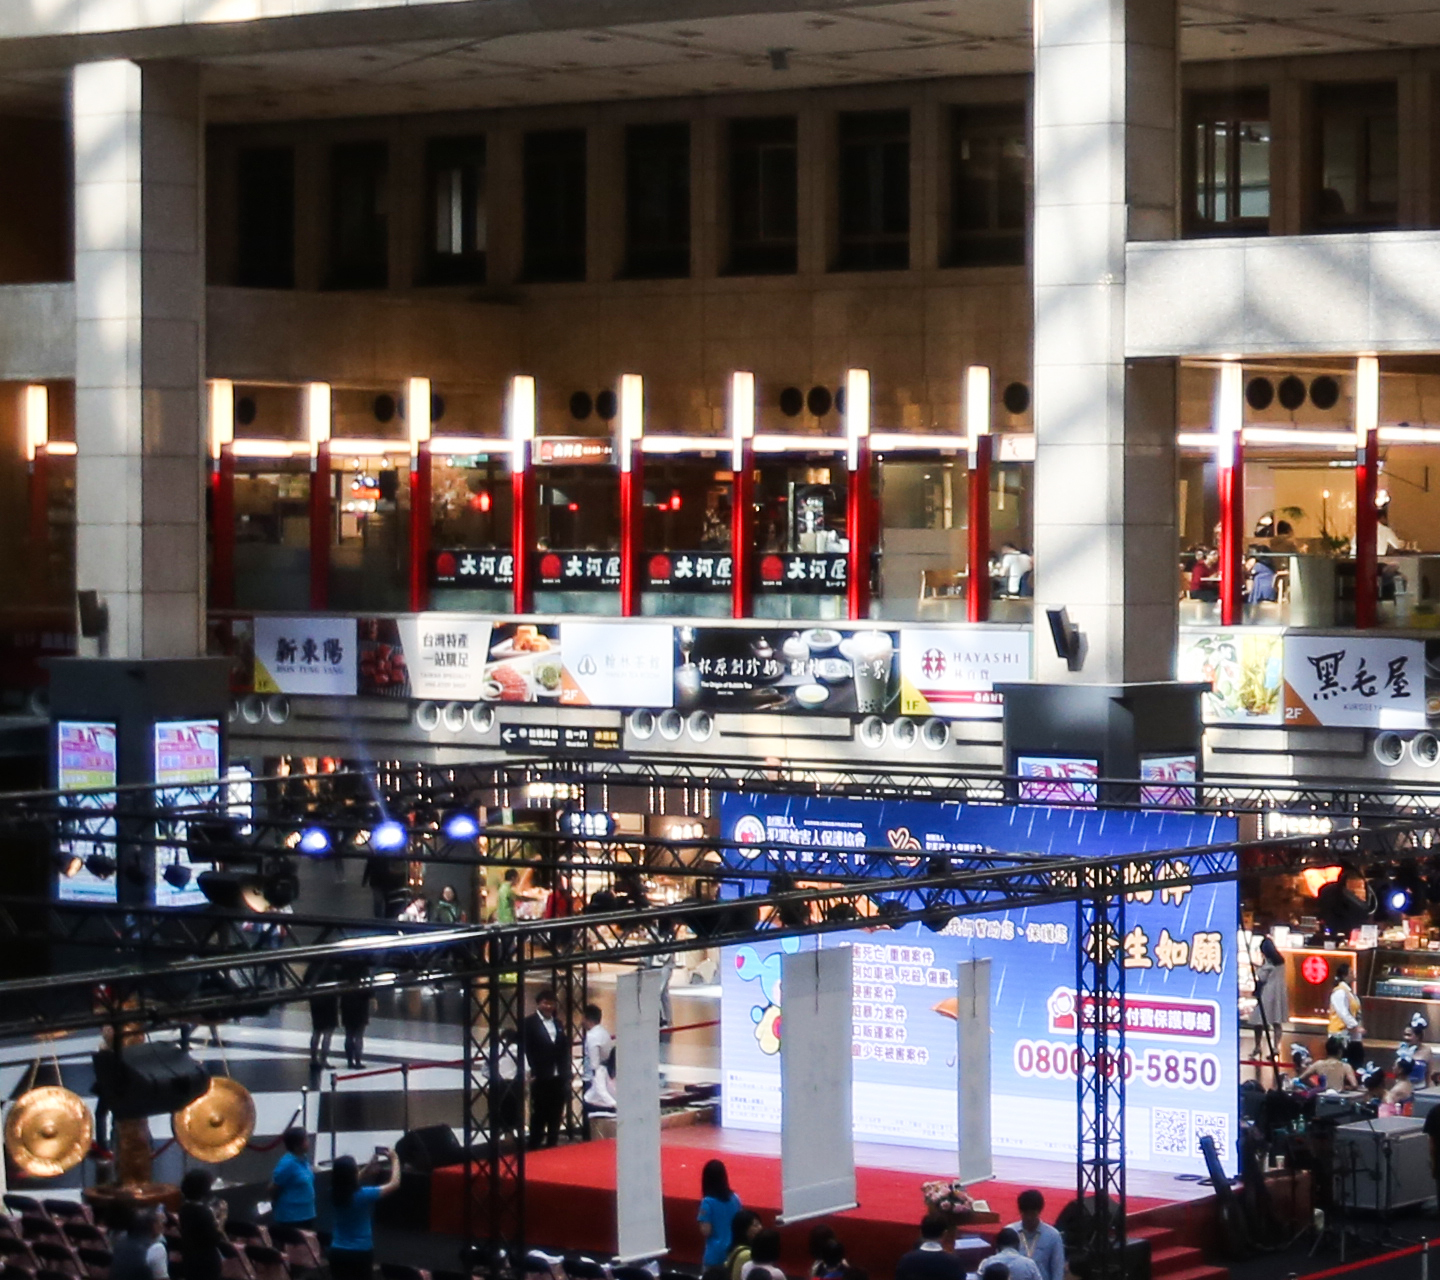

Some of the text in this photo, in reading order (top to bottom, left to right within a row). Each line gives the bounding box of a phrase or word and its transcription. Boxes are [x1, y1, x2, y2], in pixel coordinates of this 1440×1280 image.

[460, 554, 514, 579] 大河屋
[566, 554, 621, 578] 大河屋
[675, 554, 733, 579] 大河屋
[787, 555, 847, 580] 大河屋
[275, 637, 344, 665] 新東陽
[422, 632, 470, 648] 台灣特產
[422, 652, 470, 668] 一站購足
[953, 652, 1020, 664] HAYASHI
[1306, 649, 1411, 701] 黑毛屋
[563, 689, 578, 701] 2F
[906, 700, 920, 710] 1F
[1285, 707, 1304, 719] 2F
[941, 918, 1068, 944] 我們幫助您、保護您
